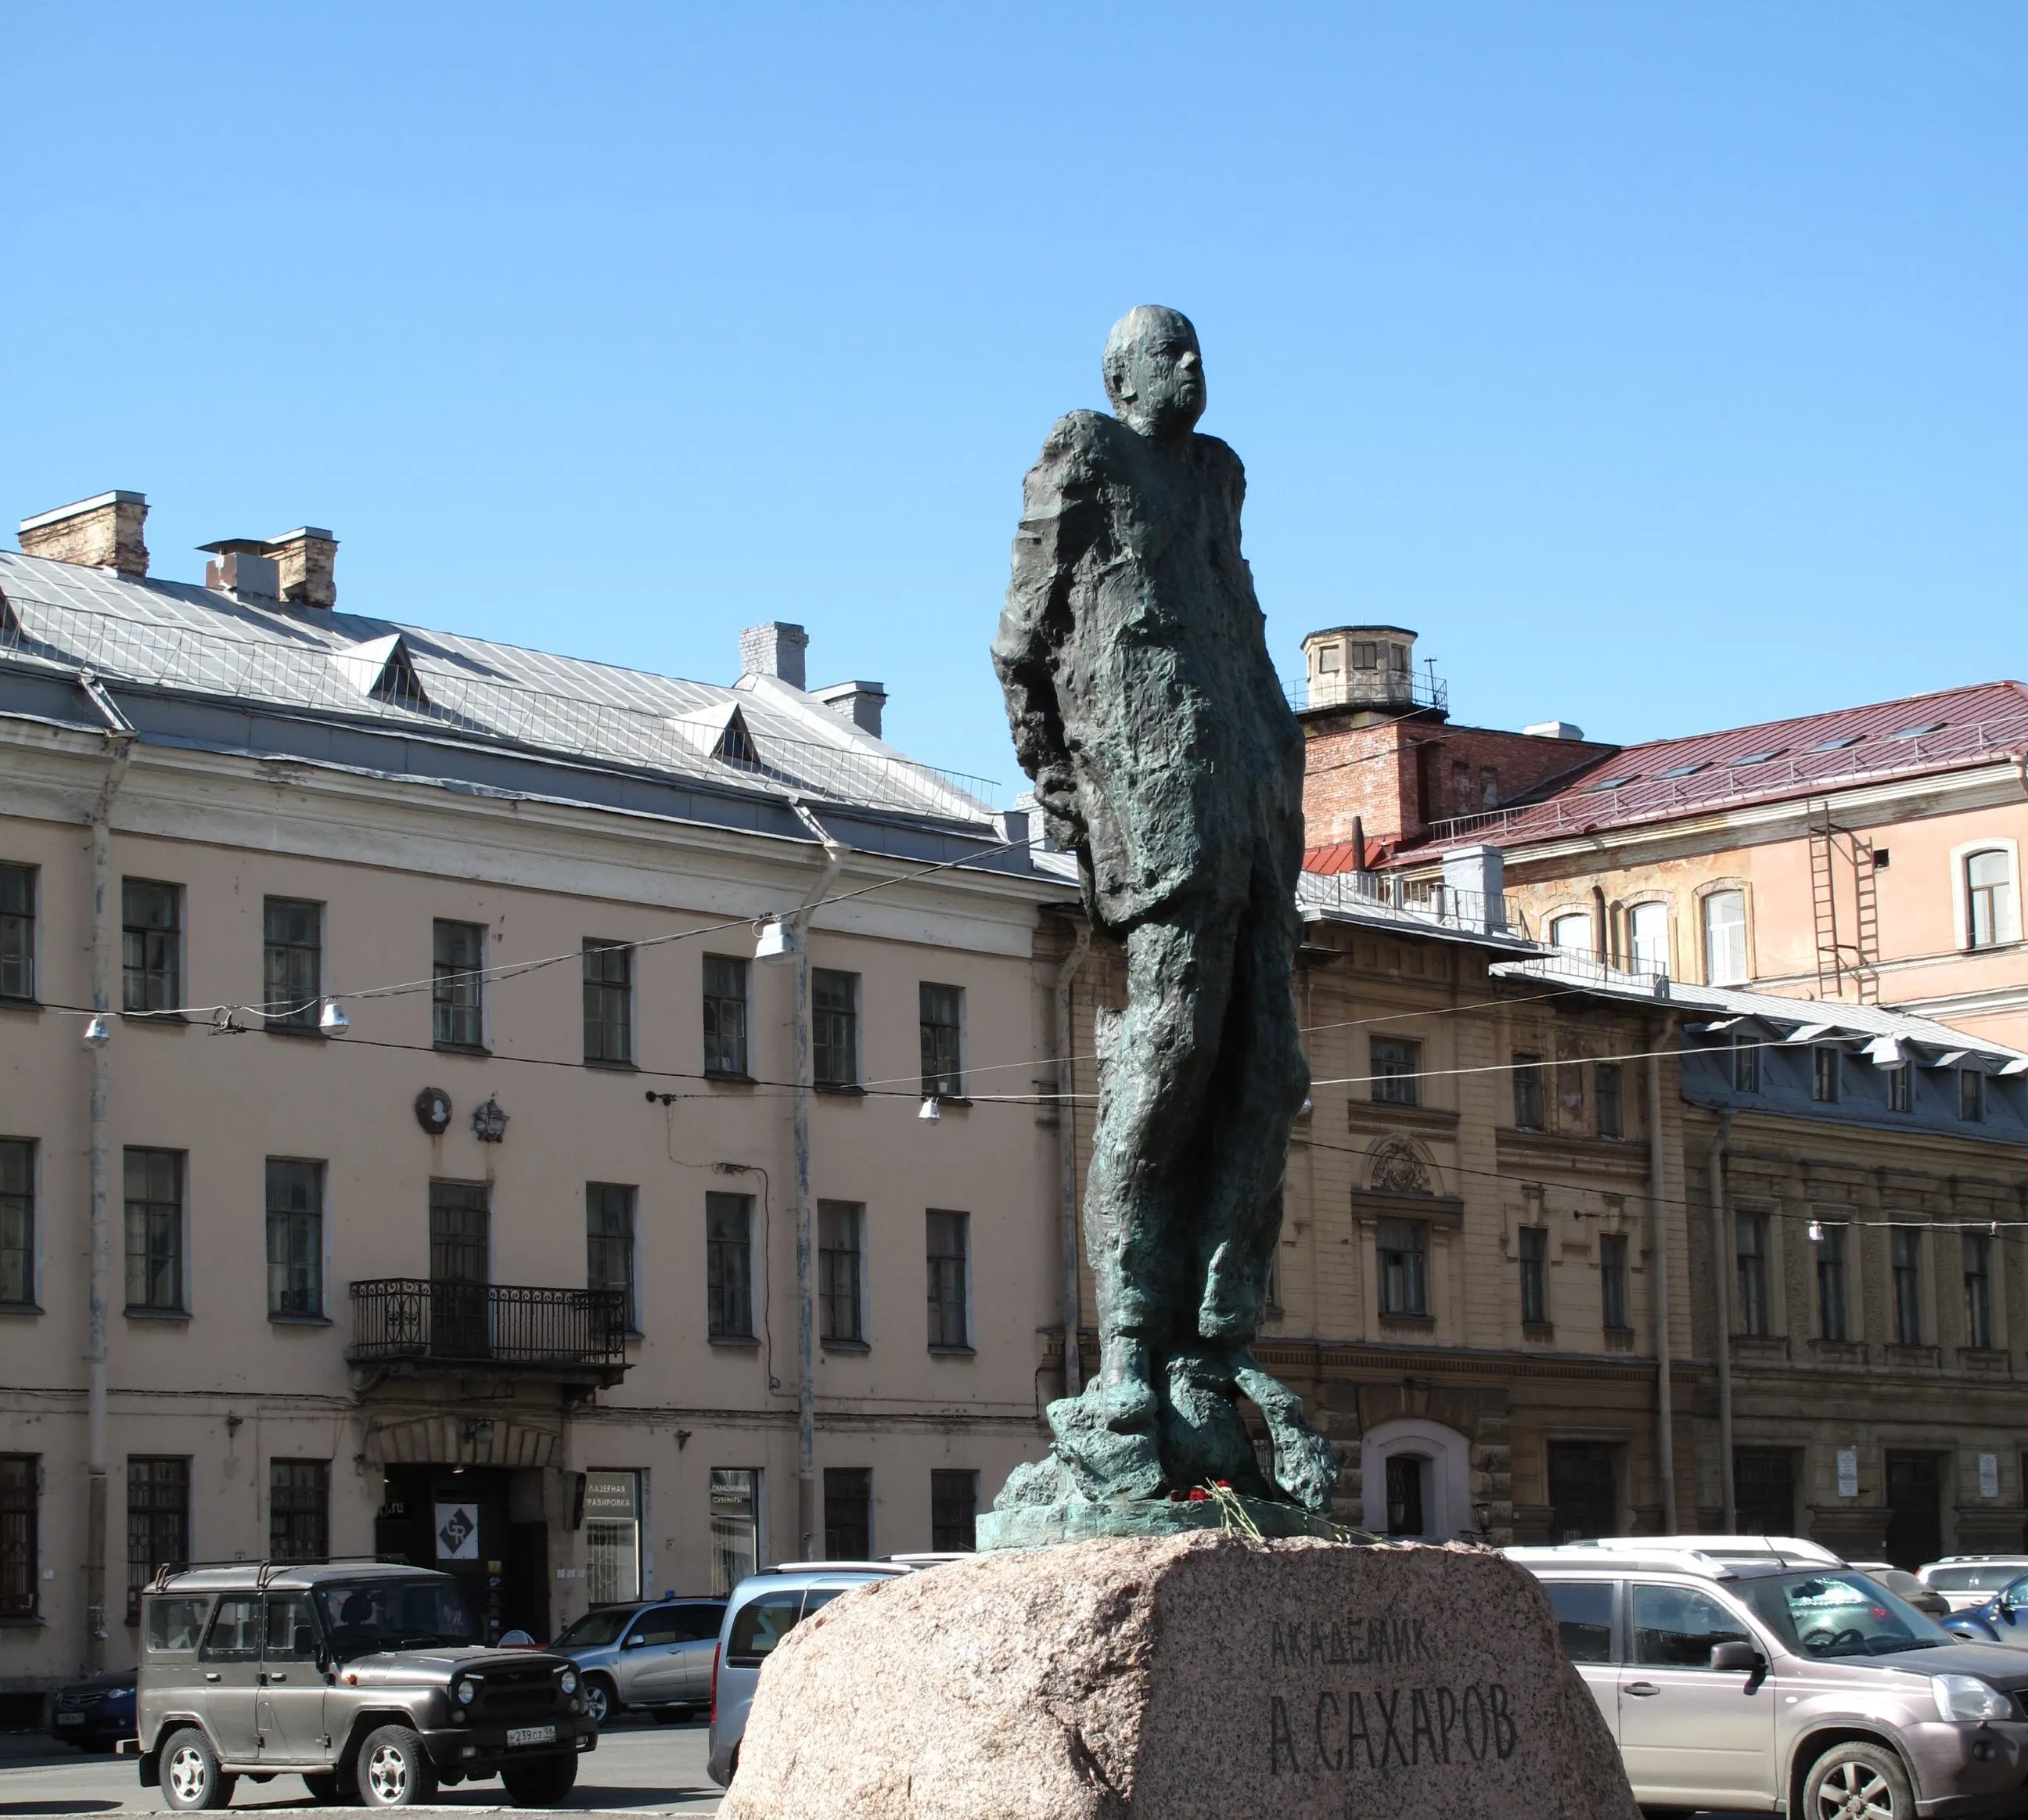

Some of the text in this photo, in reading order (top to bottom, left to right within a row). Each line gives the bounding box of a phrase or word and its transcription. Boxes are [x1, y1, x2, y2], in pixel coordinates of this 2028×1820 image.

[588, 1484, 626, 1493] ЛАЗЕРНАЯ
[1271, 1617, 1434, 1667] АКАДЕМИК
[1270, 1683, 1518, 1776] А САХАРОВ
